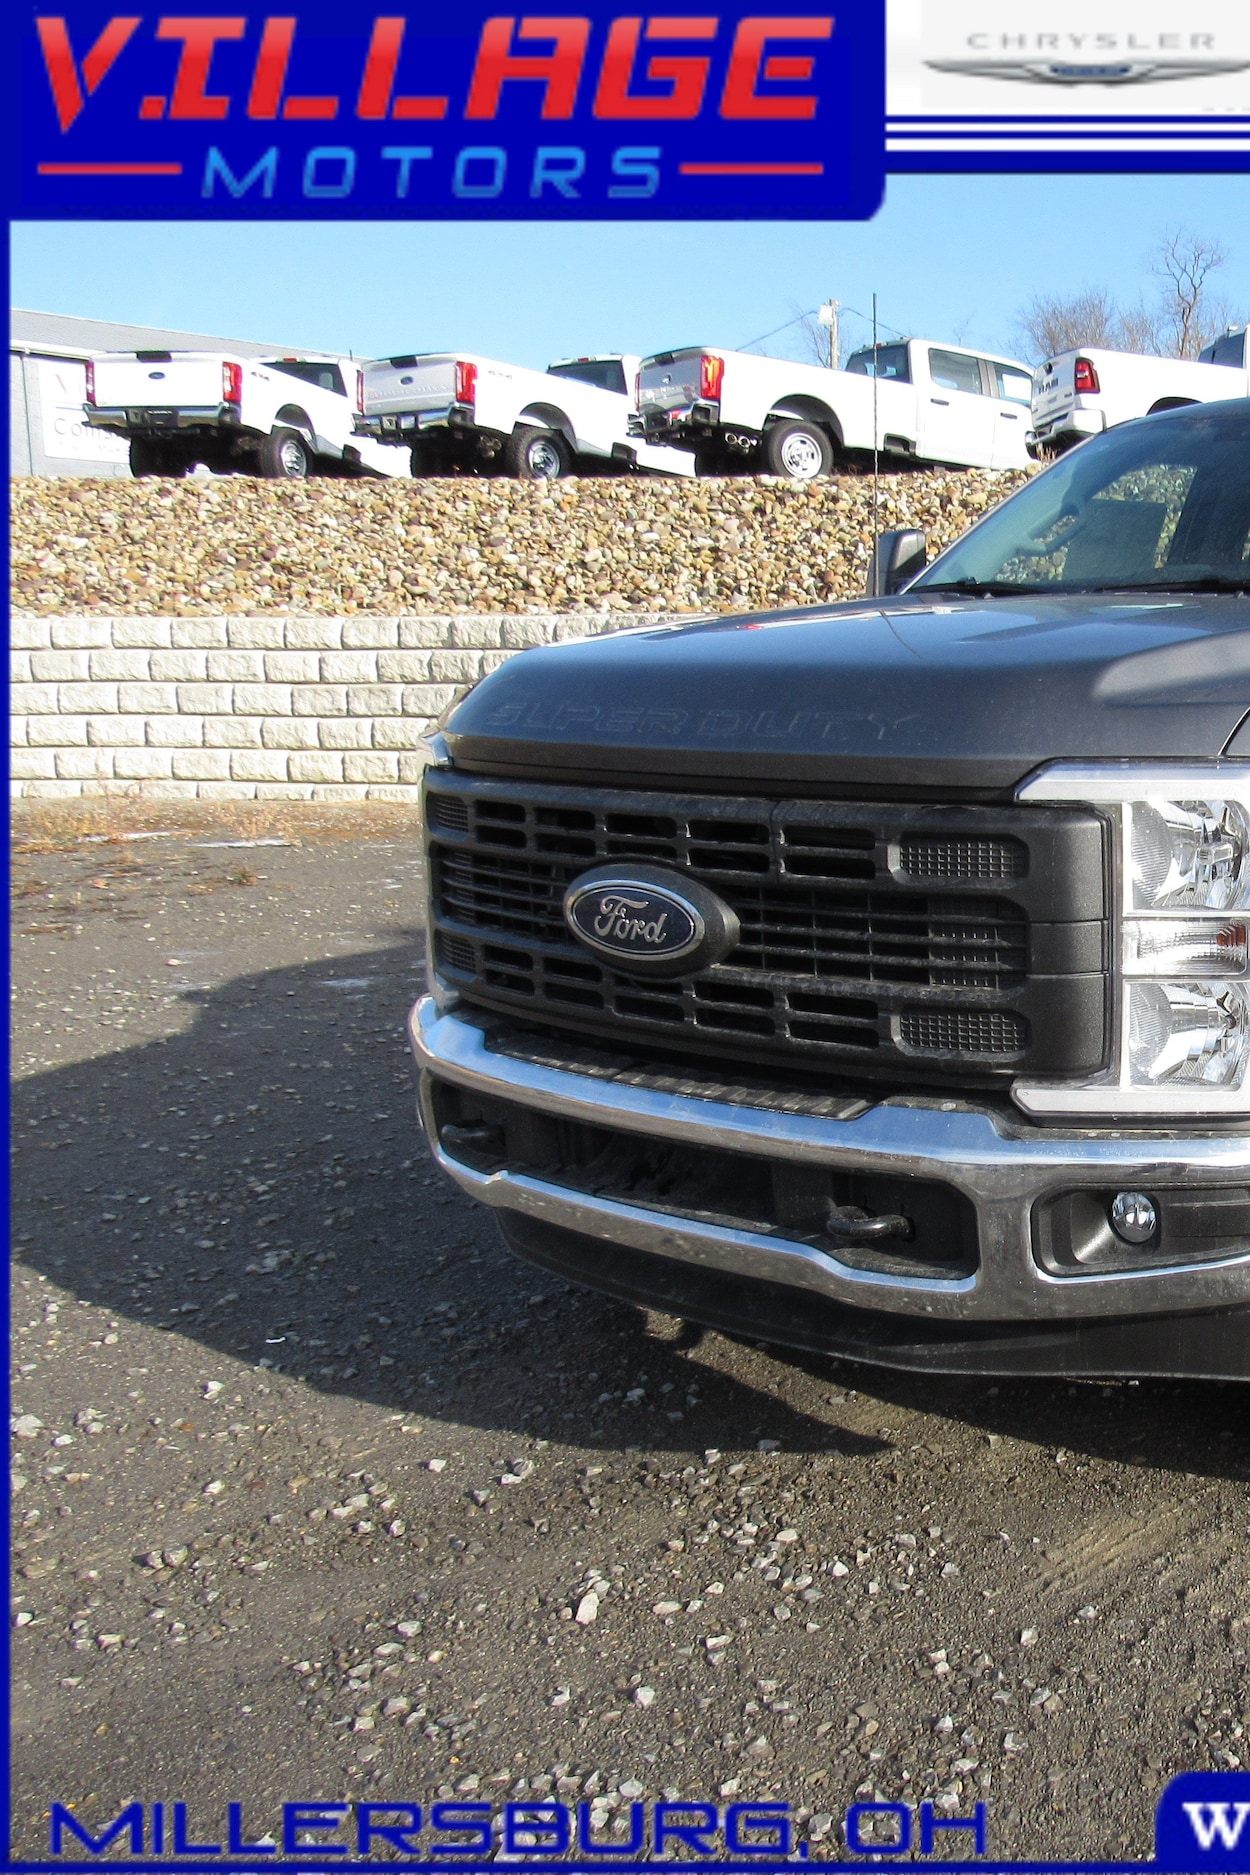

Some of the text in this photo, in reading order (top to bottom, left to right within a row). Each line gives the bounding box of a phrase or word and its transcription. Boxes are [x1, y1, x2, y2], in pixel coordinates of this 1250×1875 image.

[486, 702, 921, 742] SUPER DUTY
[593, 894, 668, 944] Ford
